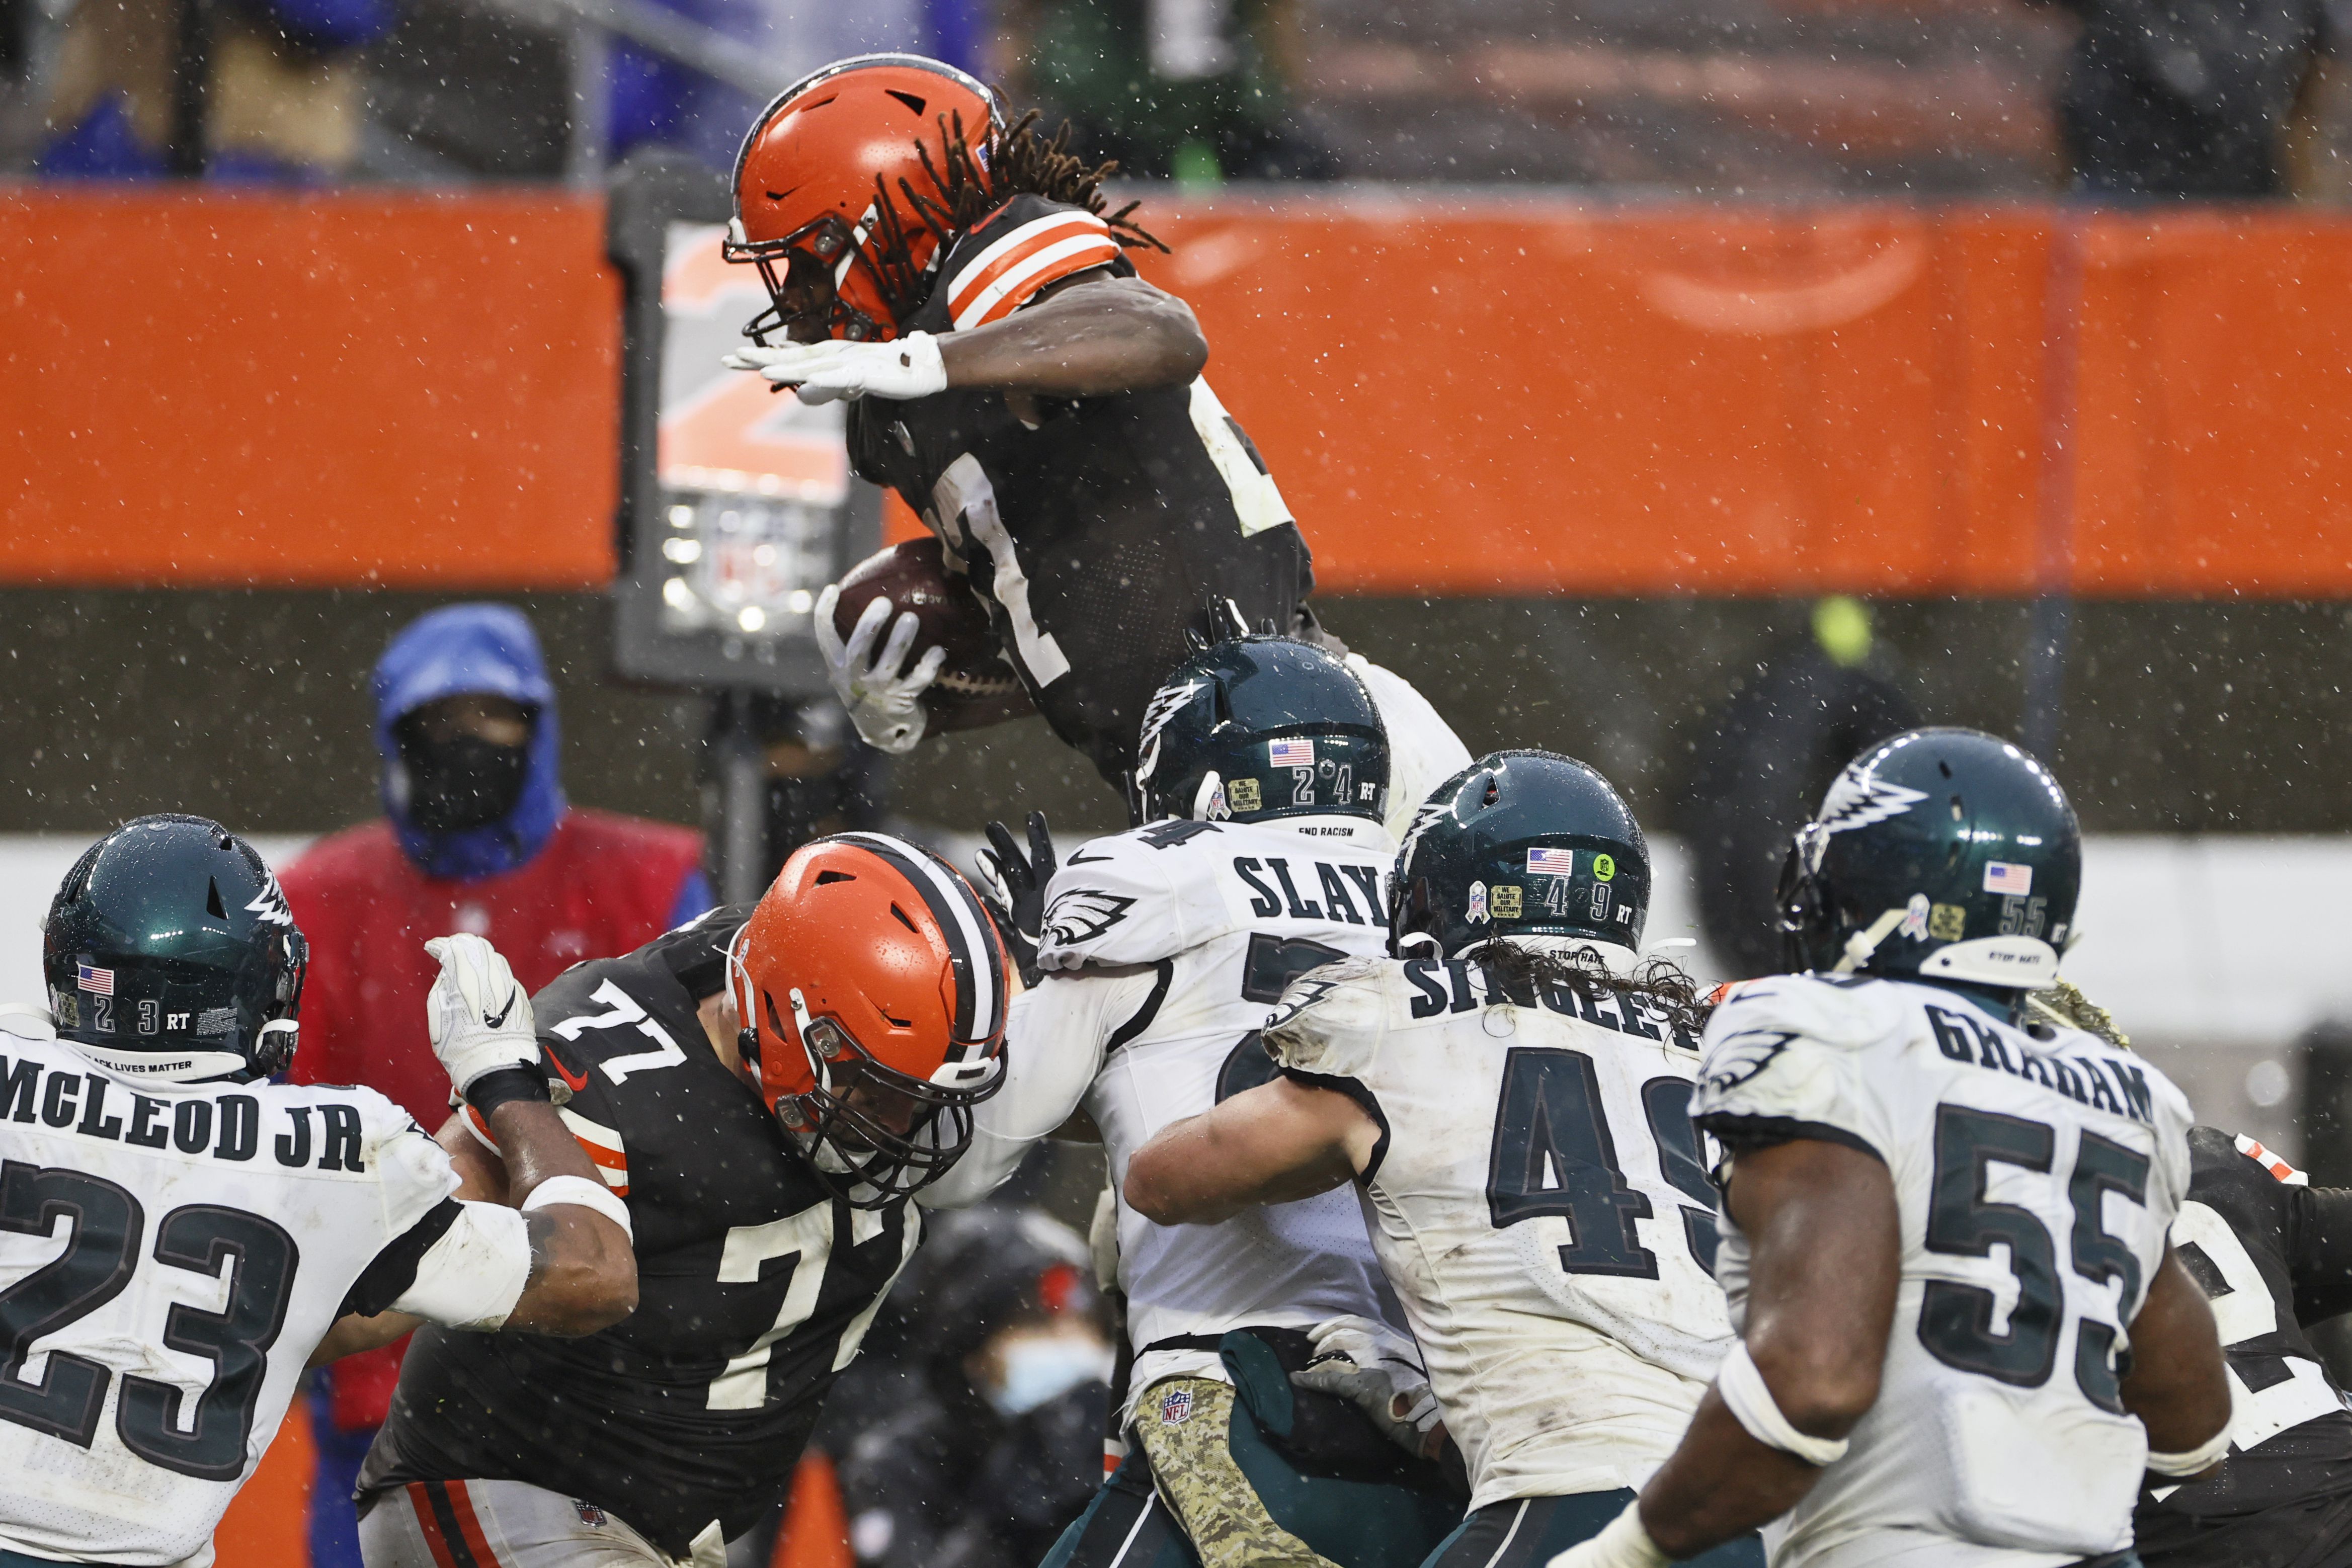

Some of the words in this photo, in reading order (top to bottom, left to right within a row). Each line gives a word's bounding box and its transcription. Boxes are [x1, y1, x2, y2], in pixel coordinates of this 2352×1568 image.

[1360, 782, 1376, 801] RT
[1299, 827, 1318, 837] END
[1320, 827, 1354, 837] RACISM
[1233, 856, 1390, 928] SLAY
[1472, 902, 1484, 911] NFL
[1616, 904, 1633, 925] RT
[1550, 950, 1578, 960] STOP
[167, 1013, 190, 1030] RT
[548, 977, 688, 1087] 77
[114, 1062, 146, 1072] LIVES
[148, 1060, 193, 1072] MATTER
[0, 1055, 259, 1162] MCLEOD
[274, 1104, 365, 1173] JR
[1917, 1101, 2151, 1418] 55
[0, 1159, 300, 1482] 23
[1164, 1404, 1187, 1421] NFL
